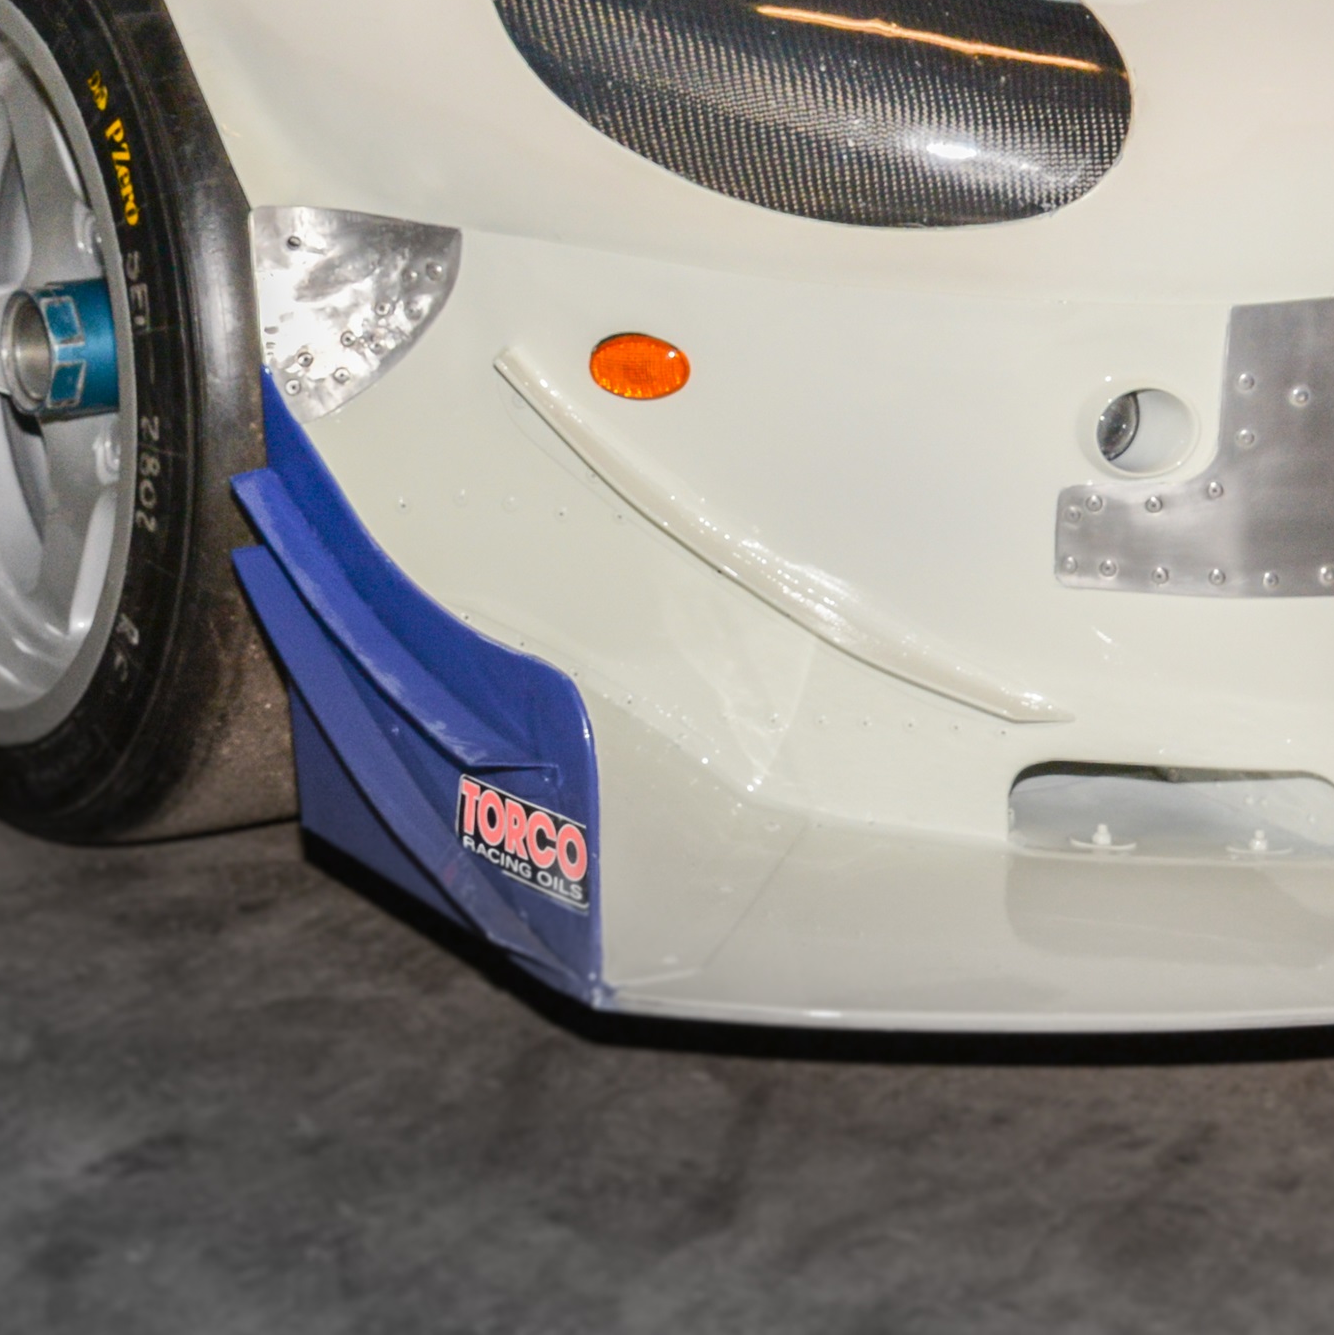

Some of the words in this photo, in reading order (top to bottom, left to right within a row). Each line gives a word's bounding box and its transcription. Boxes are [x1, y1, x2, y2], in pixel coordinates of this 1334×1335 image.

[461, 778, 588, 883] TORCO
[462, 834, 533, 879] RACING
[536, 869, 584, 902] OILS
